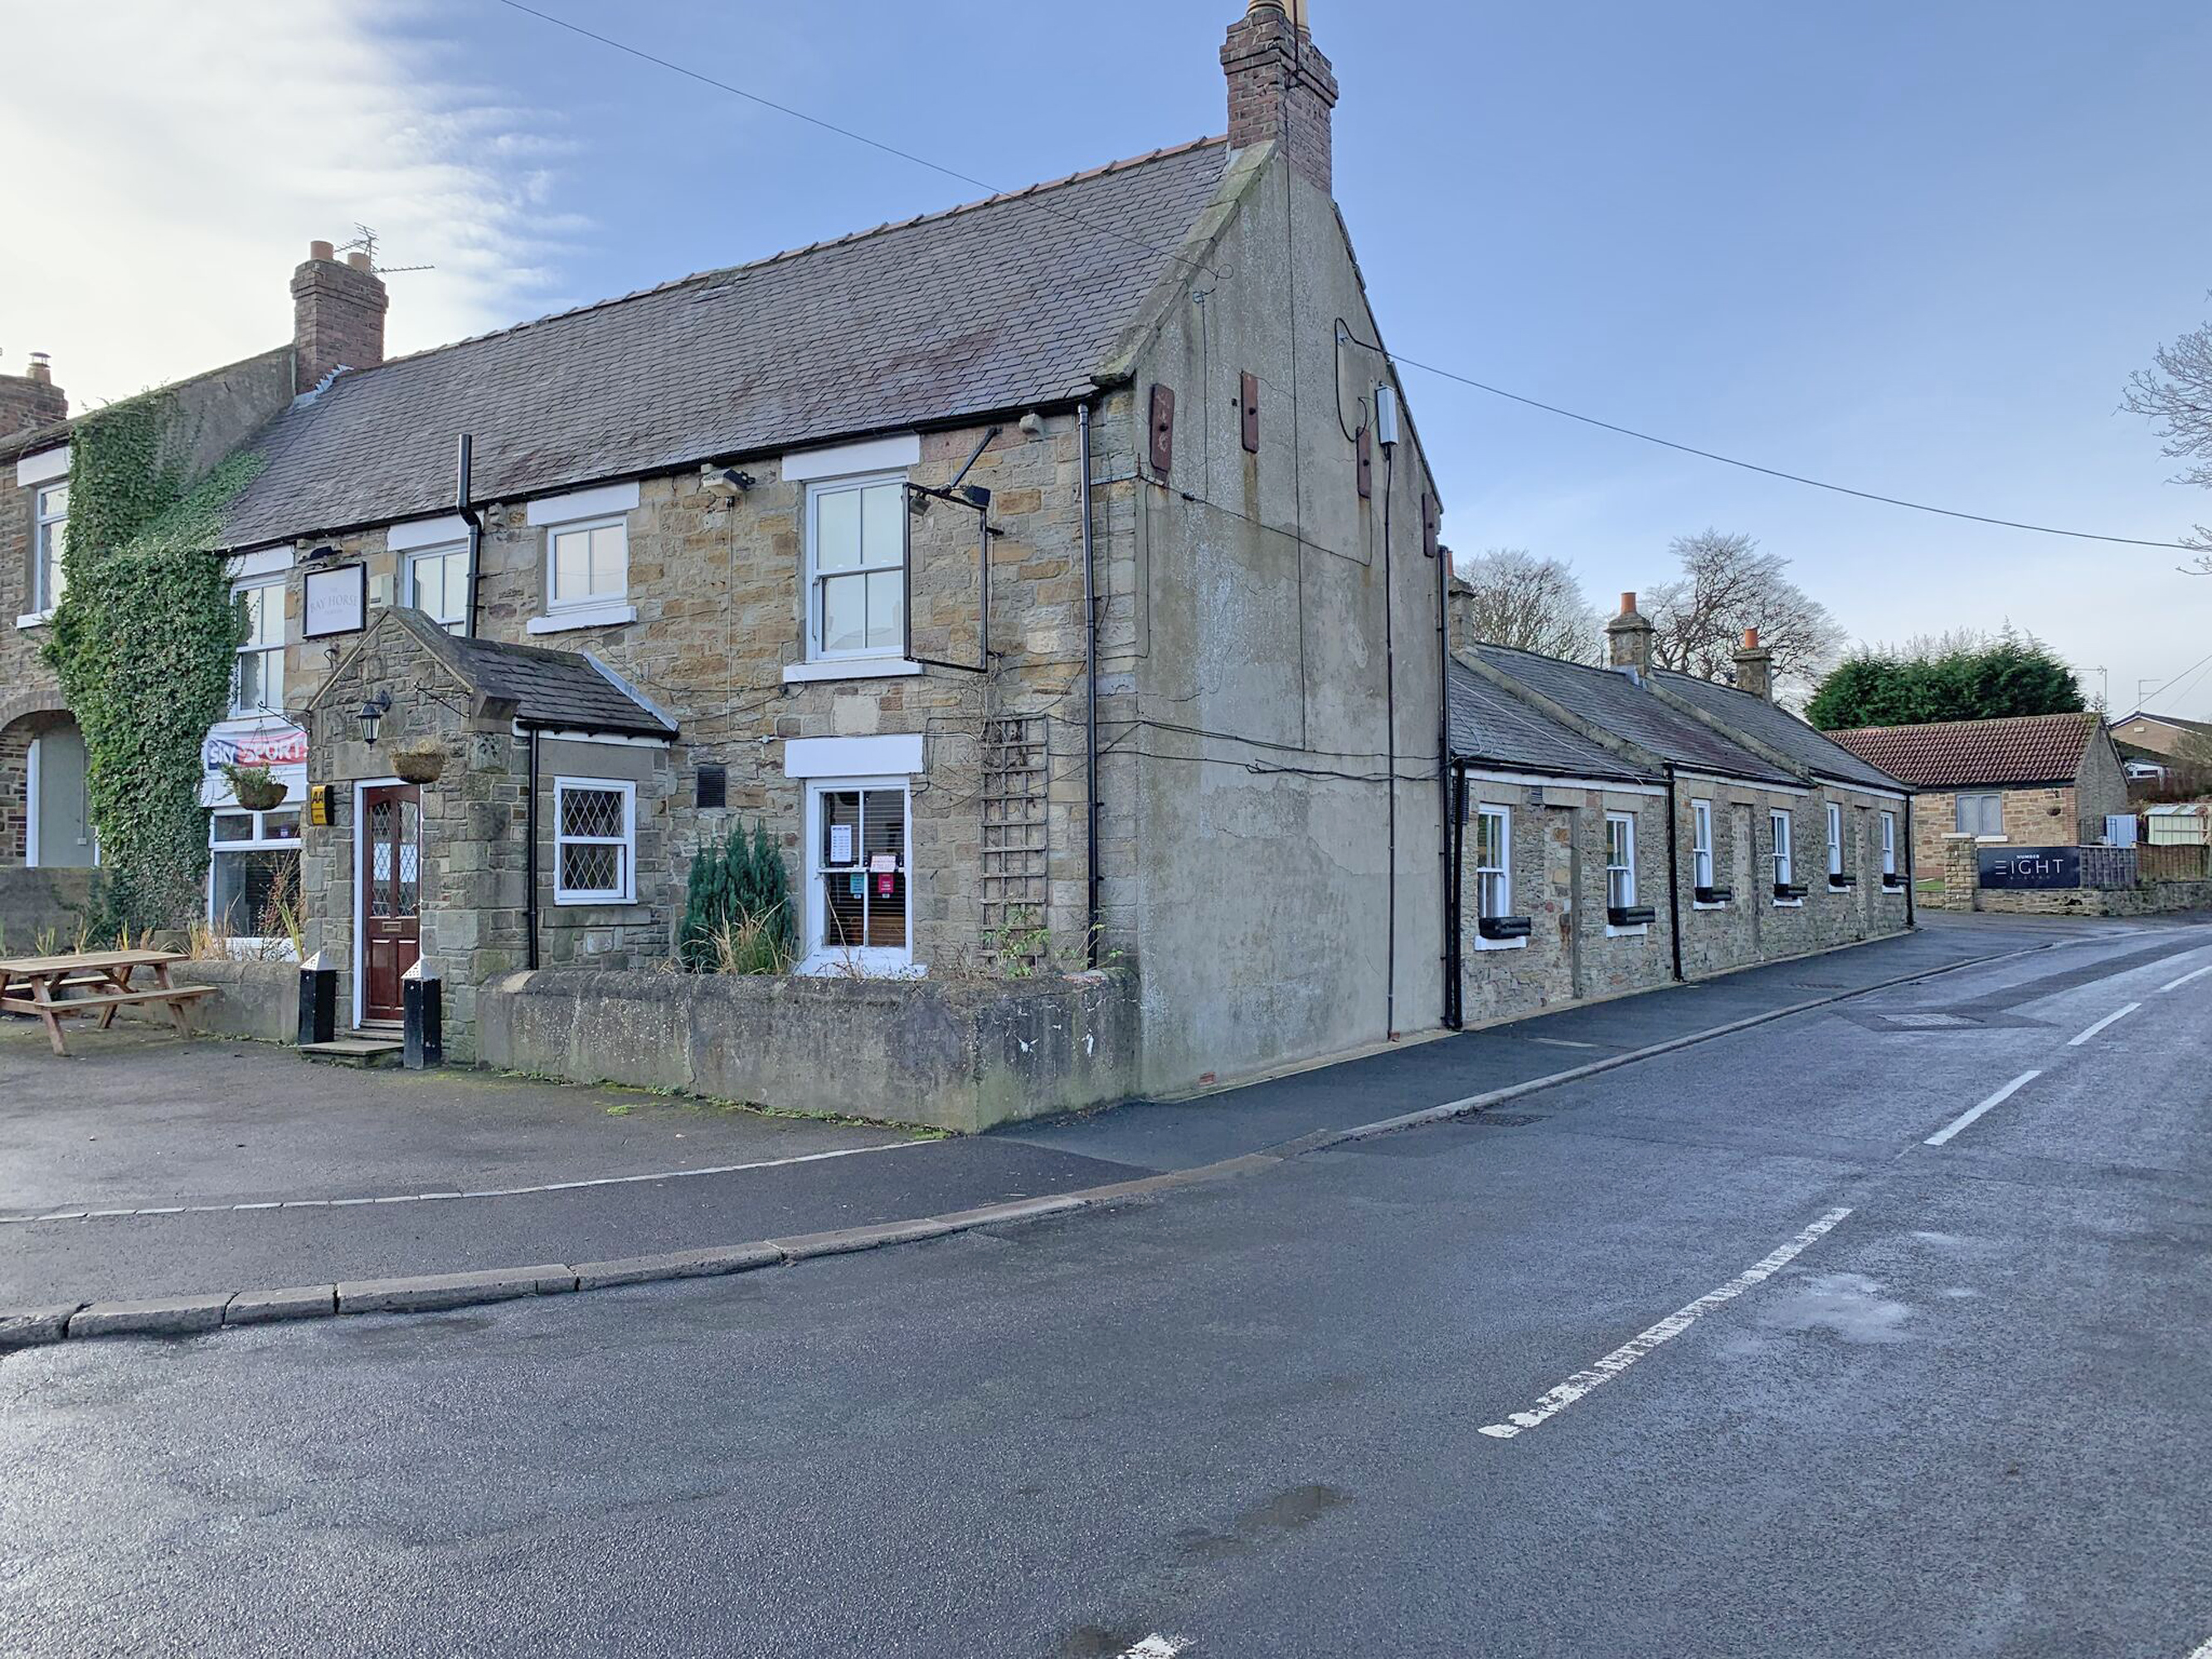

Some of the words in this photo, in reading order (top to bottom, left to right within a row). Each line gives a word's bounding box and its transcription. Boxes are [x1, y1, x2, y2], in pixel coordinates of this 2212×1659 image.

[310, 596, 326, 614] BAY
[328, 594, 359, 606] HORSE
[210, 746, 236, 764] SKY
[312, 791, 325, 804] AA
[1995, 859, 2064, 875] EIGHT
